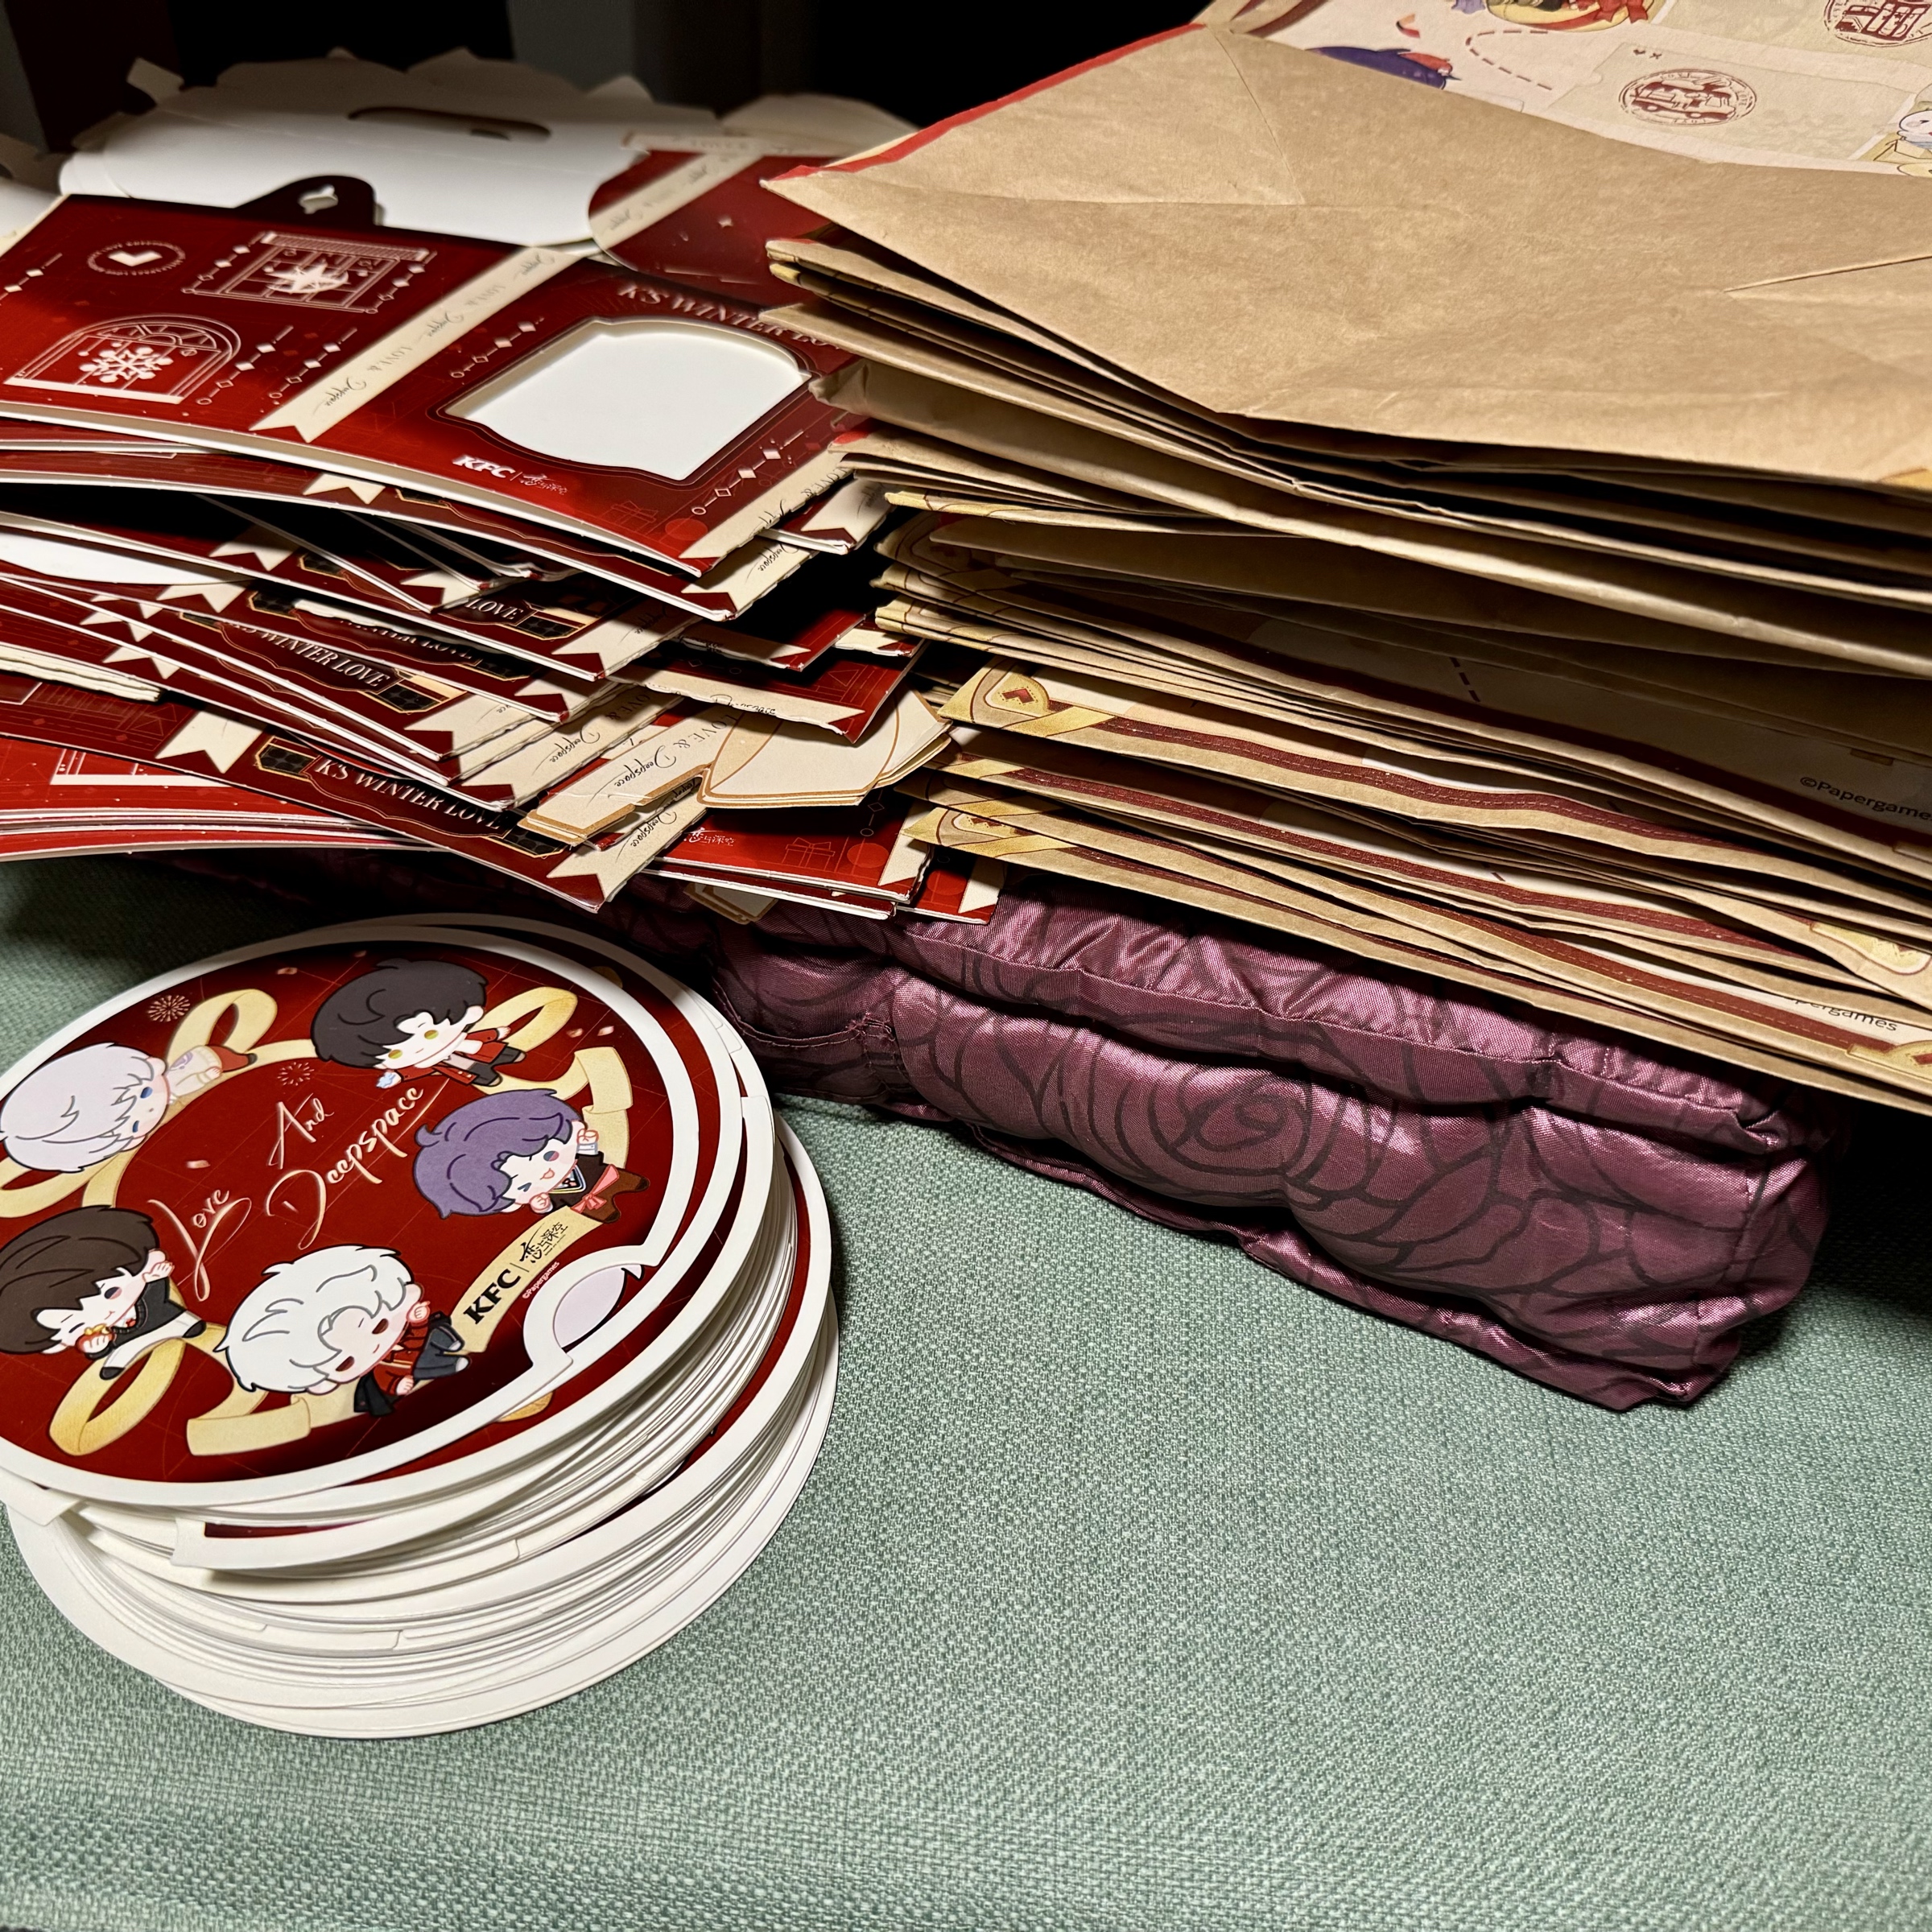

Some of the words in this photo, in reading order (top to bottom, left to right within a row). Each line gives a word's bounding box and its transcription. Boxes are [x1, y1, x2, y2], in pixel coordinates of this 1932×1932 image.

[452, 454, 516, 479] KFC
[464, 597, 524, 621] LOVE
[259, 632, 339, 667] WINTER
[330, 654, 392, 687] LOVE
[531, 725, 601, 776] Deepspace
[673, 738, 691, 749] &
[315, 758, 351, 781] K'S
[354, 771, 445, 811] WINTER
[587, 745, 677, 807] Deepspace
[616, 810, 678, 861] Deepspace
[266, 1078, 450, 1250] Deepspace
[147, 1188, 253, 1302] Love
[267, 1092, 335, 1170] And
[463, 1268, 522, 1325] KFC
[518, 1221, 568, 1264] 恋与深空
